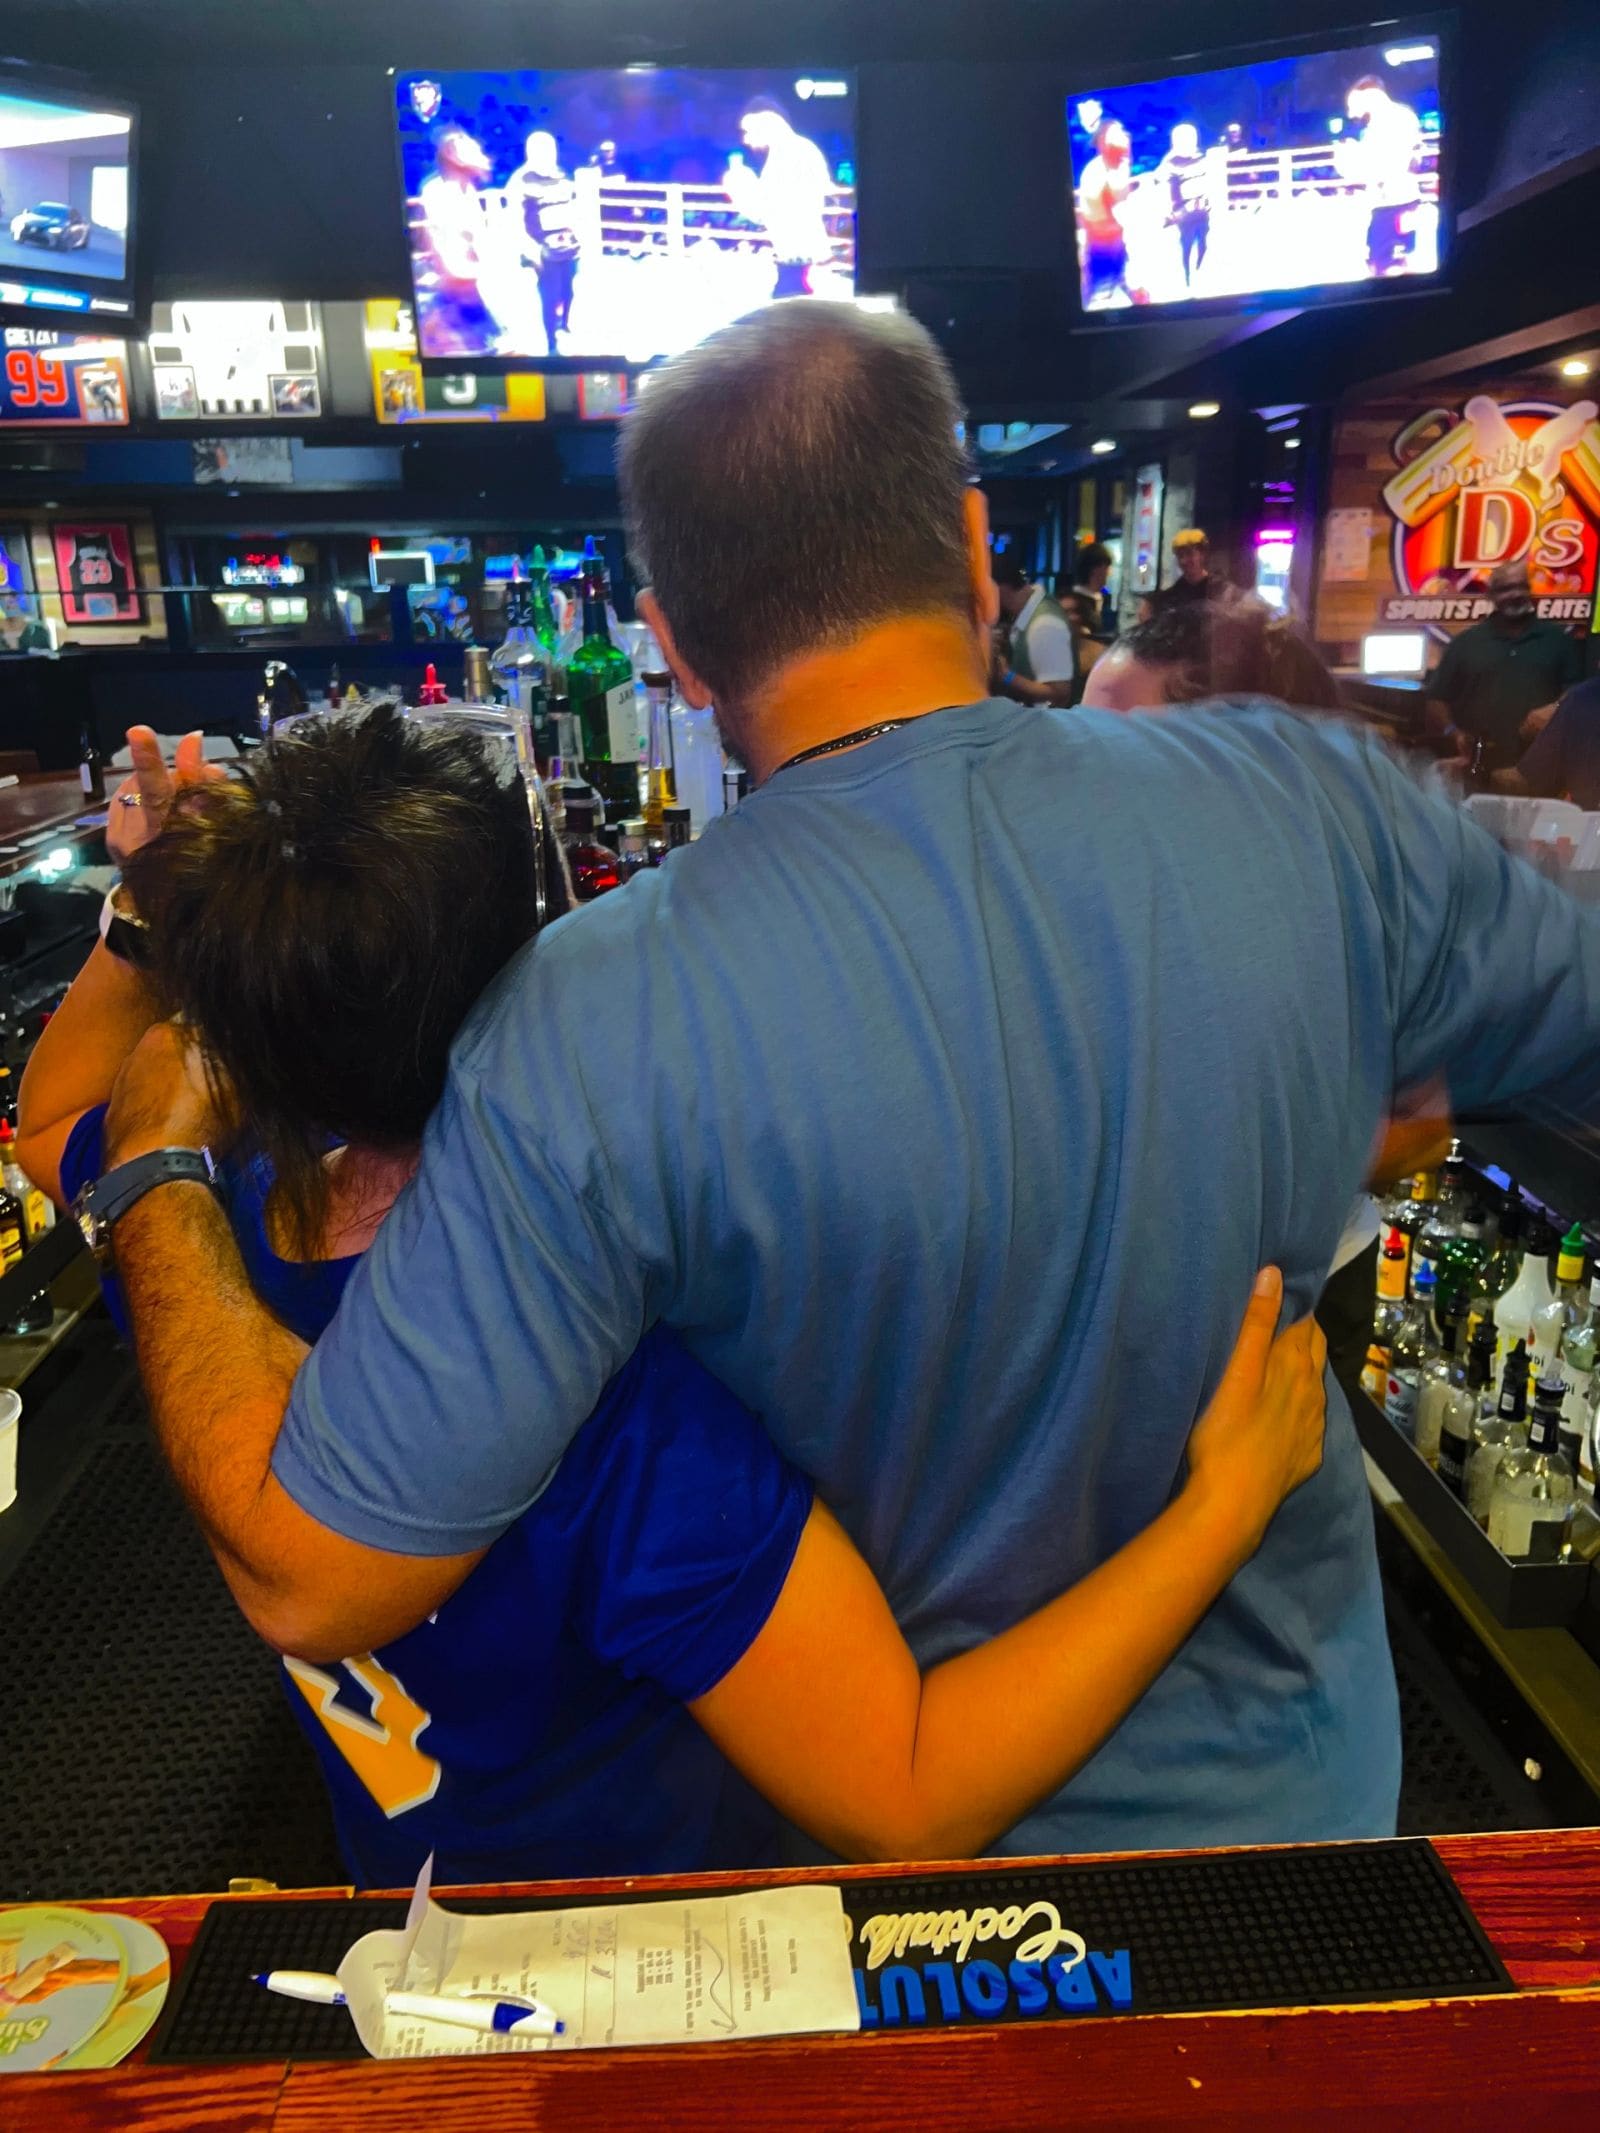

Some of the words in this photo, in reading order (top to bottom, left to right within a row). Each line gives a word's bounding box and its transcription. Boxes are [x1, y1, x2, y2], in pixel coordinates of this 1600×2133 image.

[5, 350, 69, 407] 99
[1426, 443, 1546, 495] Double
[1454, 481, 1584, 569] D's
[1385, 599, 1471, 620] SPORTS
[859, 1900, 1087, 1973] Cocktails
[852, 1949, 1133, 2030] ABSOLUT
